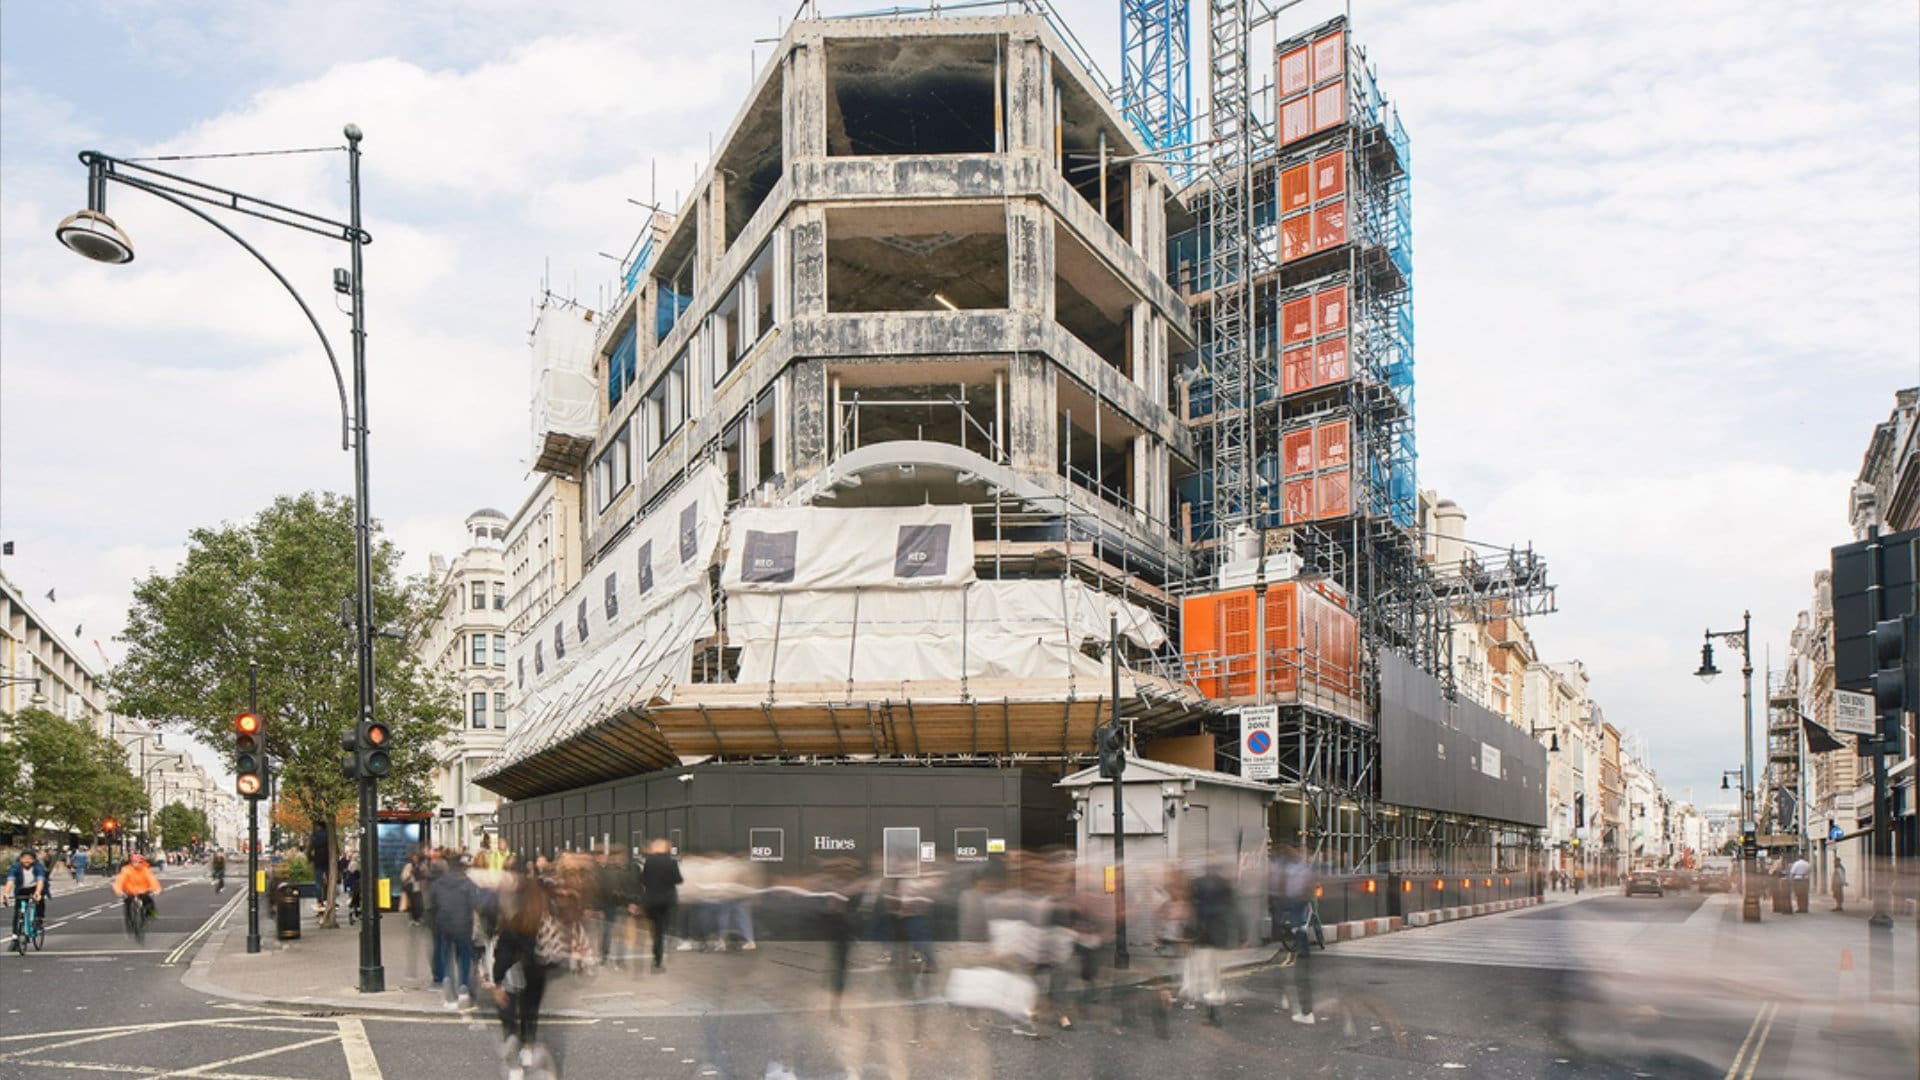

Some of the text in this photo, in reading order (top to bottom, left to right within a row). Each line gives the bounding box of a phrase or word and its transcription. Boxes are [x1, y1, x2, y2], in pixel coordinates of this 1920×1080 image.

[1247, 721, 1270, 730] ZONE
[814, 835, 856, 850] Hines
[752, 847, 772, 856] RED
[957, 847, 977, 856] RED
